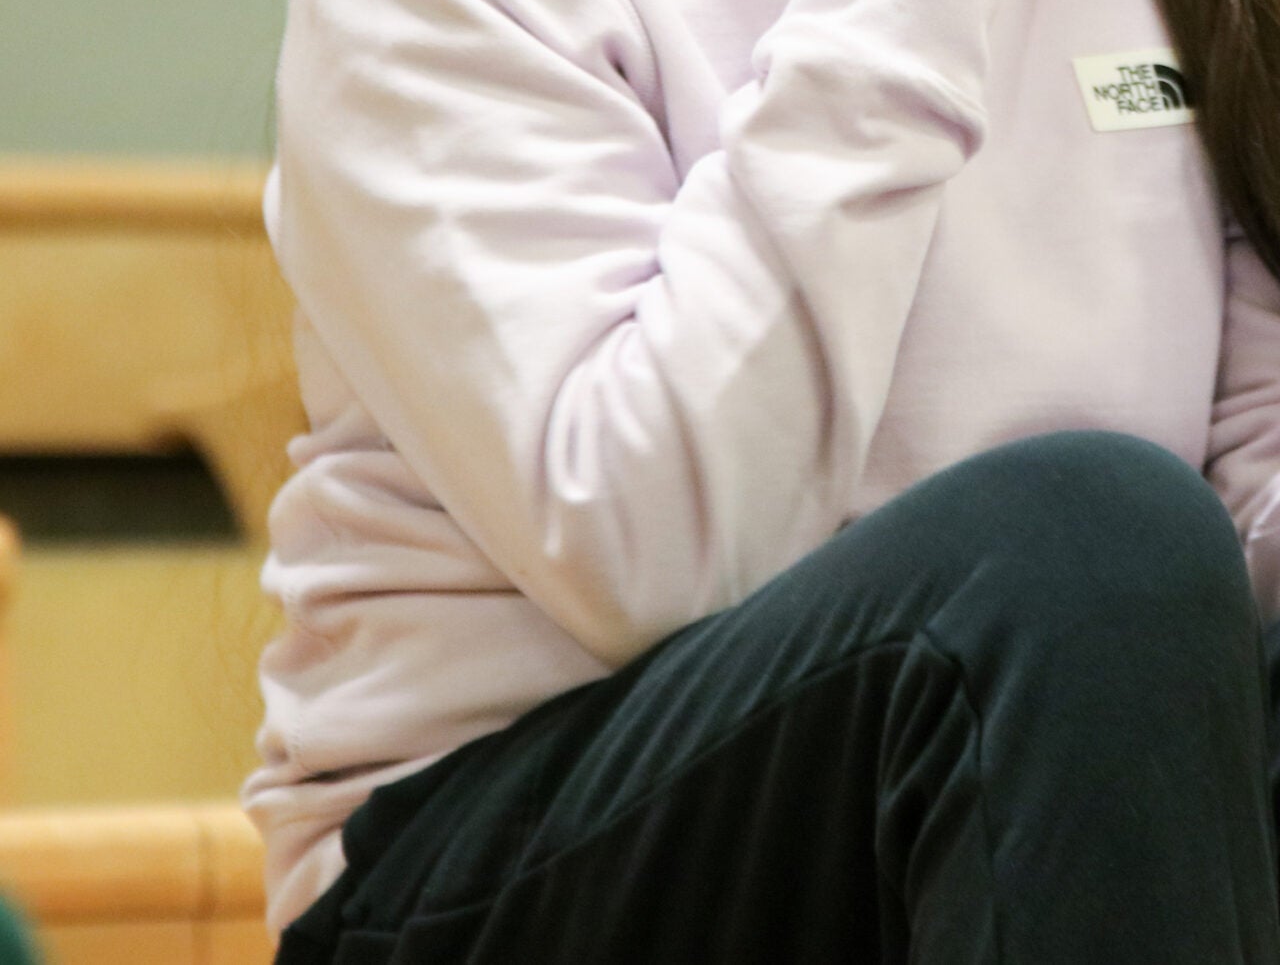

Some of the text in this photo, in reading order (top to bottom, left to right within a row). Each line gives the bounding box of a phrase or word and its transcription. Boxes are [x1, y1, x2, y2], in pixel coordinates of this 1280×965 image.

[1117, 64, 1152, 83] THE
[1093, 81, 1156, 101] NORTH
[1117, 96, 1162, 114] FACE
